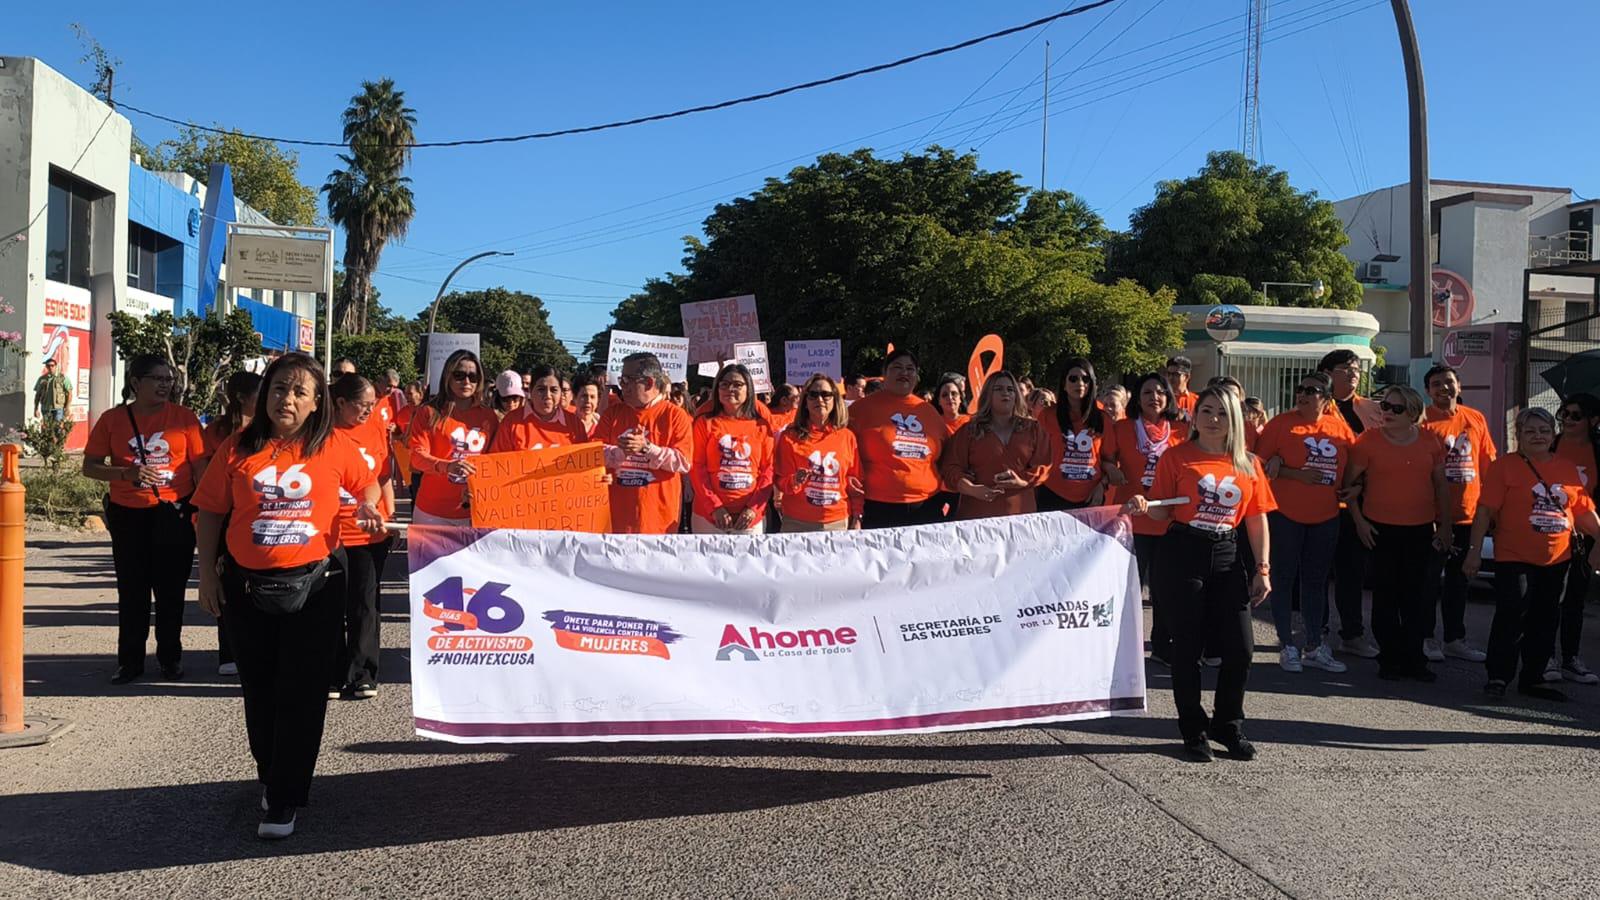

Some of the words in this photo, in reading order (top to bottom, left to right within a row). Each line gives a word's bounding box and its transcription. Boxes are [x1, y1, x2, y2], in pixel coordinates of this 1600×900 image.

[808, 349, 835, 357] LAZOS
[890, 412, 923, 433] 16
[1304, 436, 1338, 457] 16
[520, 457, 546, 475] LA
[554, 450, 601, 471] CALLE
[809, 450, 840, 476] 16
[253, 463, 313, 499] 16
[476, 485, 500, 503] NO
[509, 477, 576, 499] QUIERO
[583, 473, 604, 490] SE
[1198, 473, 1242, 506] 16
[476, 499, 557, 522] VALIENTE
[262, 534, 300, 544] MUJERES
[422, 576, 525, 634] 16
[1016, 600, 1089, 619] JORNADAS
[439, 612, 462, 621] DÍAS
[592, 619, 614, 628] PARA
[616, 621, 643, 630] PONER
[646, 623, 659, 631] FIN
[900, 615, 981, 633] SECRETARÍA
[983, 614, 1003, 625] DE
[1020, 621, 1039, 630] POR
[1042, 618, 1054, 626] LA
[1056, 612, 1090, 630] PAZ
[582, 626, 616, 635] VIOLENCIA
[617, 629, 643, 637] CONTRA
[717, 624, 858, 656] Ahome
[903, 631, 928, 642] LAS
[931, 625, 992, 639] MUJERES
[435, 637, 453, 649] DE
[456, 637, 526, 650] ACTIVISMO
[580, 636, 649, 653] MUJERES
[763, 650, 775, 658] La
[778, 649, 801, 657] Casa
[806, 648, 818, 656] de
[820, 646, 852, 655] Todos
[427, 653, 535, 666] #NOHAYEXCUSA
